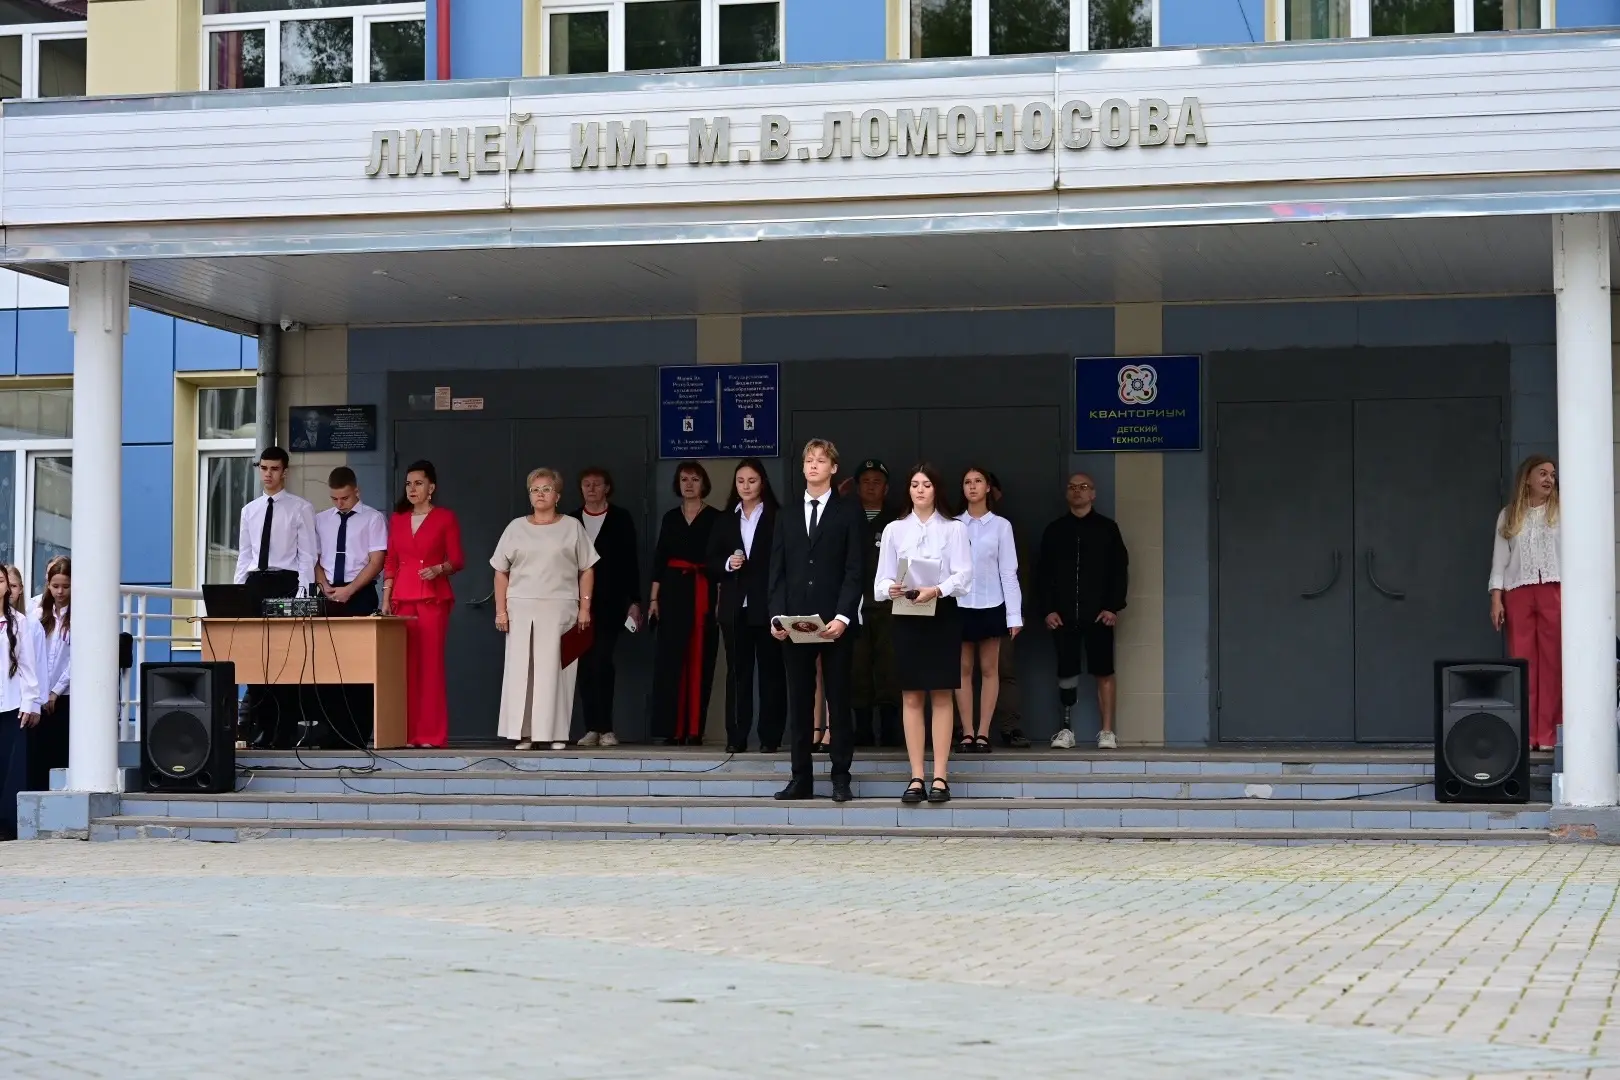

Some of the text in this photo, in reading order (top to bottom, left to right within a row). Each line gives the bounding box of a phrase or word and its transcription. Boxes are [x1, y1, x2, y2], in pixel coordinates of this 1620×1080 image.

[365, 112, 536, 179] ЛИЦЕЙ
[570, 119, 668, 169] ИМ.
[1089, 409, 1186, 419] КВАНТОРИУМ
[1116, 425, 1158, 434] ДЕТСКИЙ
[1111, 436, 1164, 444] ТЕХНОПАРК
